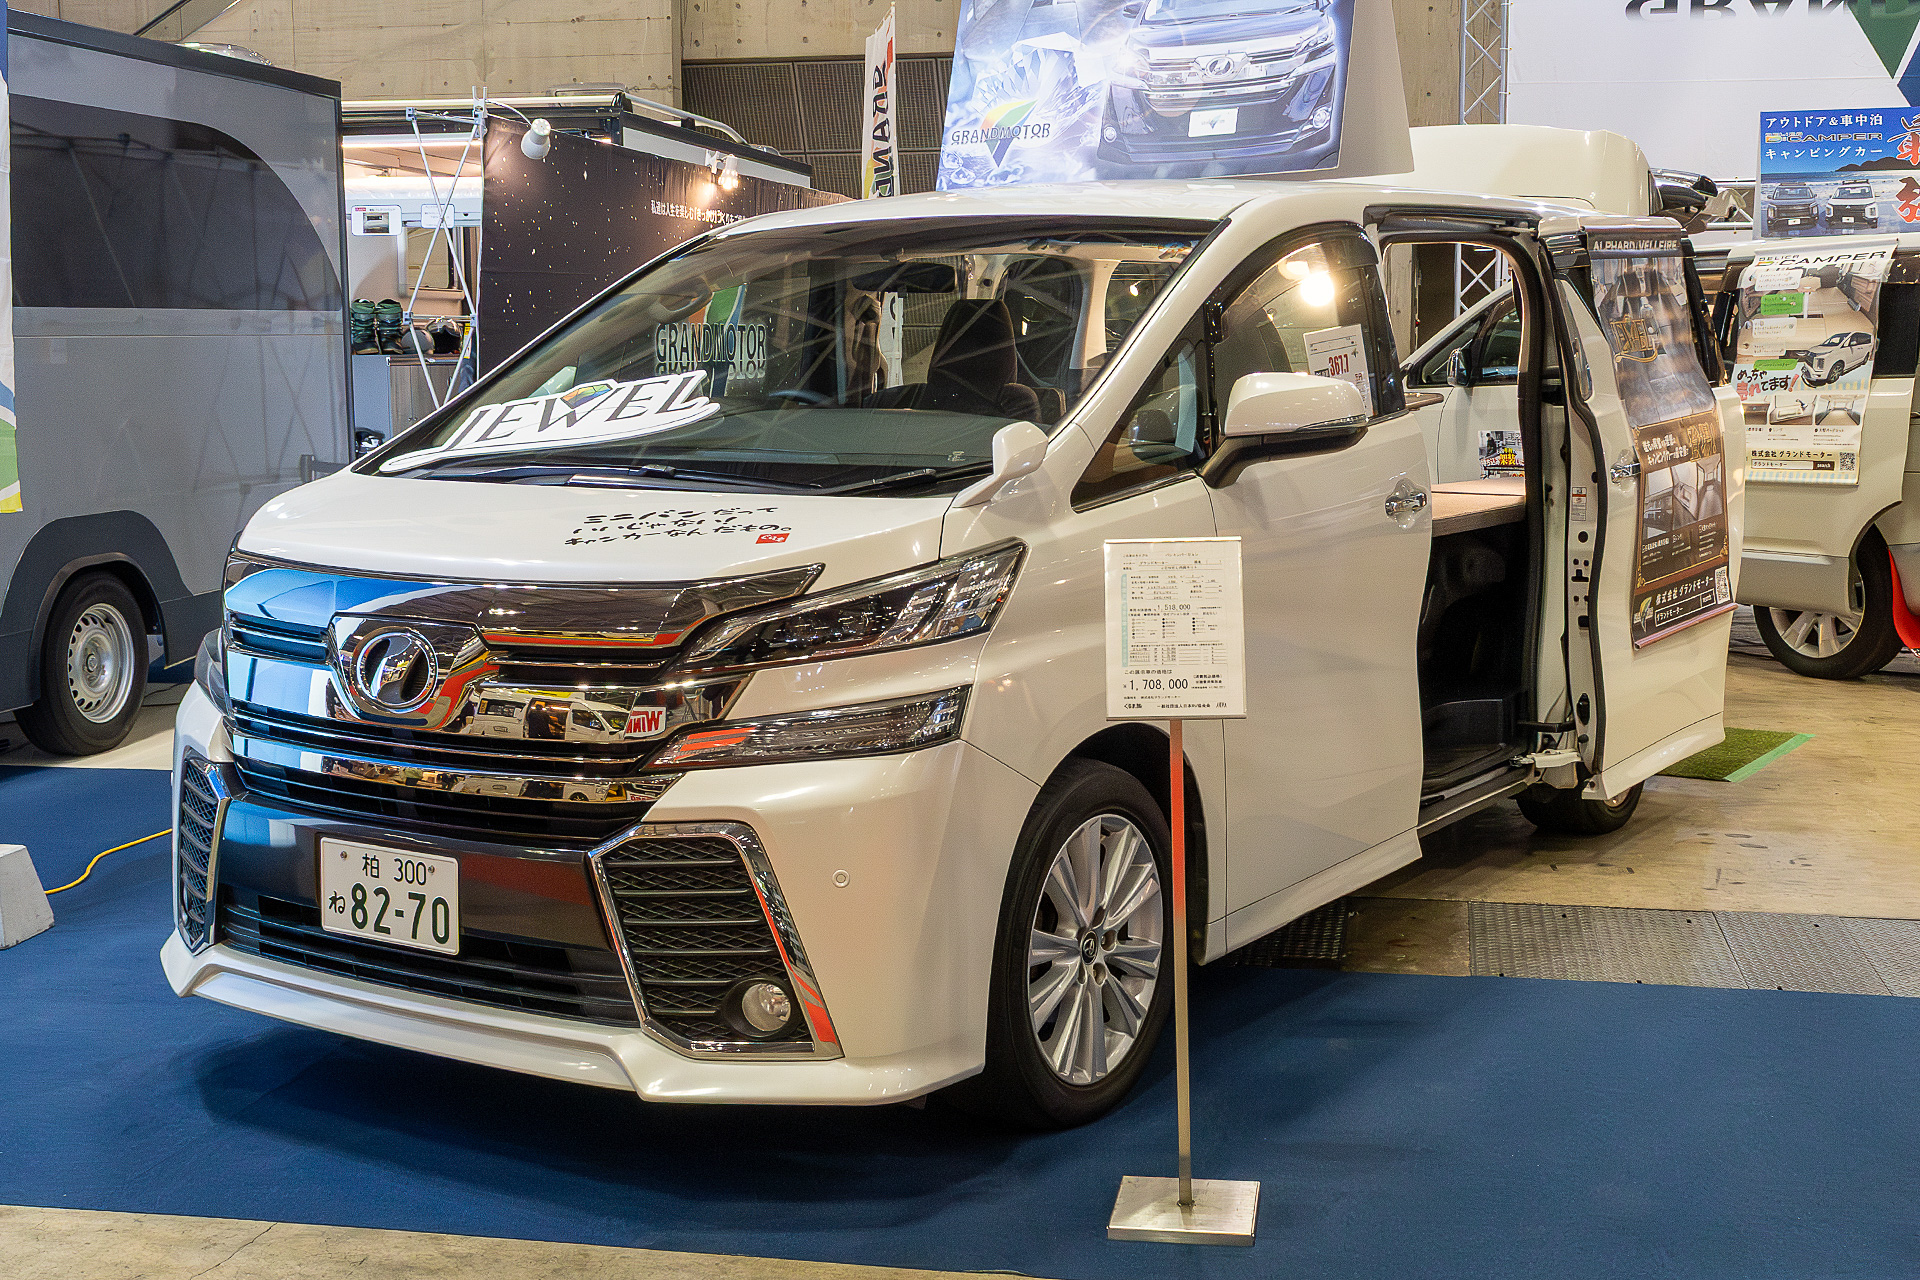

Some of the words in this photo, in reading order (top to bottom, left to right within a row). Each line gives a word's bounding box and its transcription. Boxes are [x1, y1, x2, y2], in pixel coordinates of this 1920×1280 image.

[951, 123, 1051, 144] GRANDMOTOR
[1765, 146, 1883, 160] キャンピングカー
[655, 323, 767, 363] GRANDMOTOR
[1737, 369, 1768, 383] めっちゃ
[450, 376, 703, 451] JEWEL
[362, 853, 380, 878] 柏
[393, 858, 427, 886] 300
[328, 890, 346, 914] ね
[351, 882, 450, 945] 82-70
